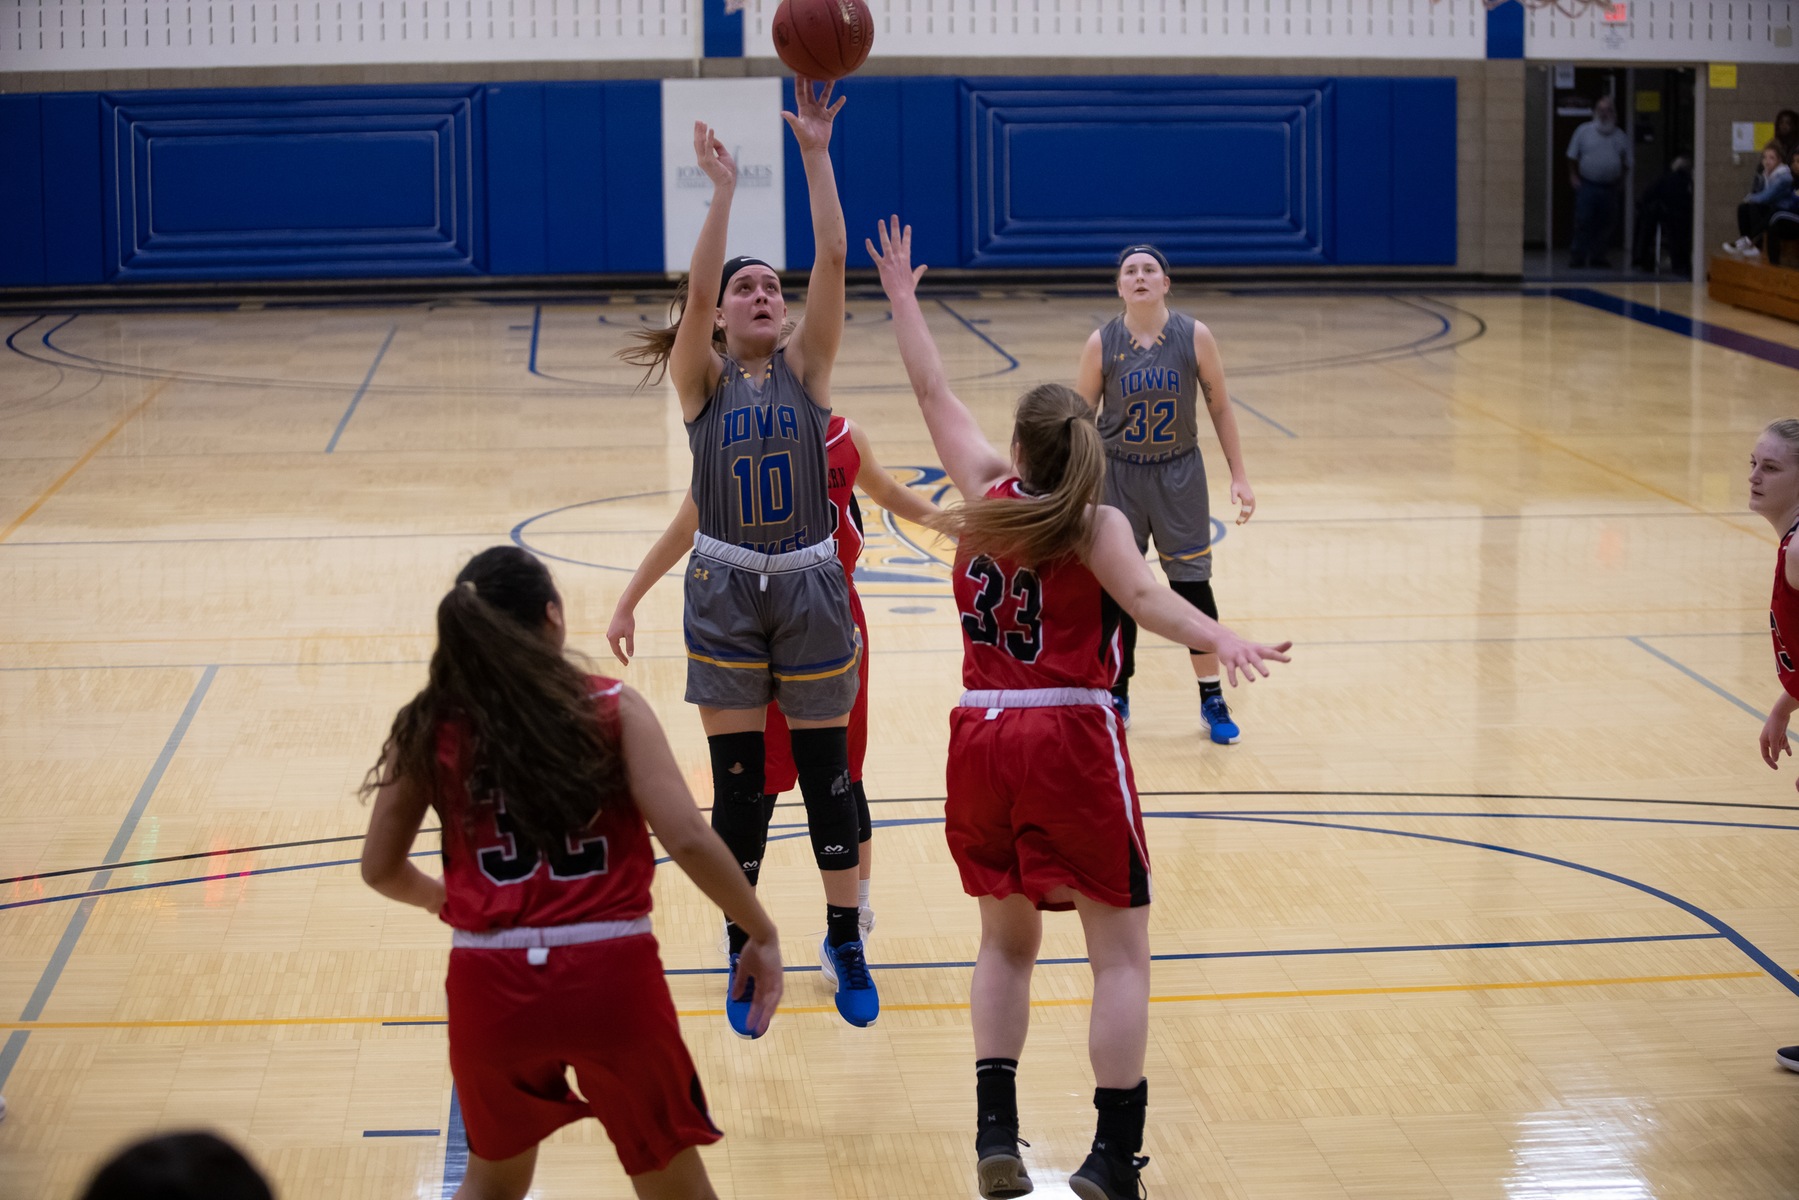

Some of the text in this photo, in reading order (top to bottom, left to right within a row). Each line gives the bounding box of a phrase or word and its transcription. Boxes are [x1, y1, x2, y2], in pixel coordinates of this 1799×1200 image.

[1120, 366, 1182, 398] IOWA
[720, 404, 800, 450] IOWA
[1123, 399, 1177, 445] 32
[731, 450, 795, 527] 10
[961, 553, 1043, 664] 33
